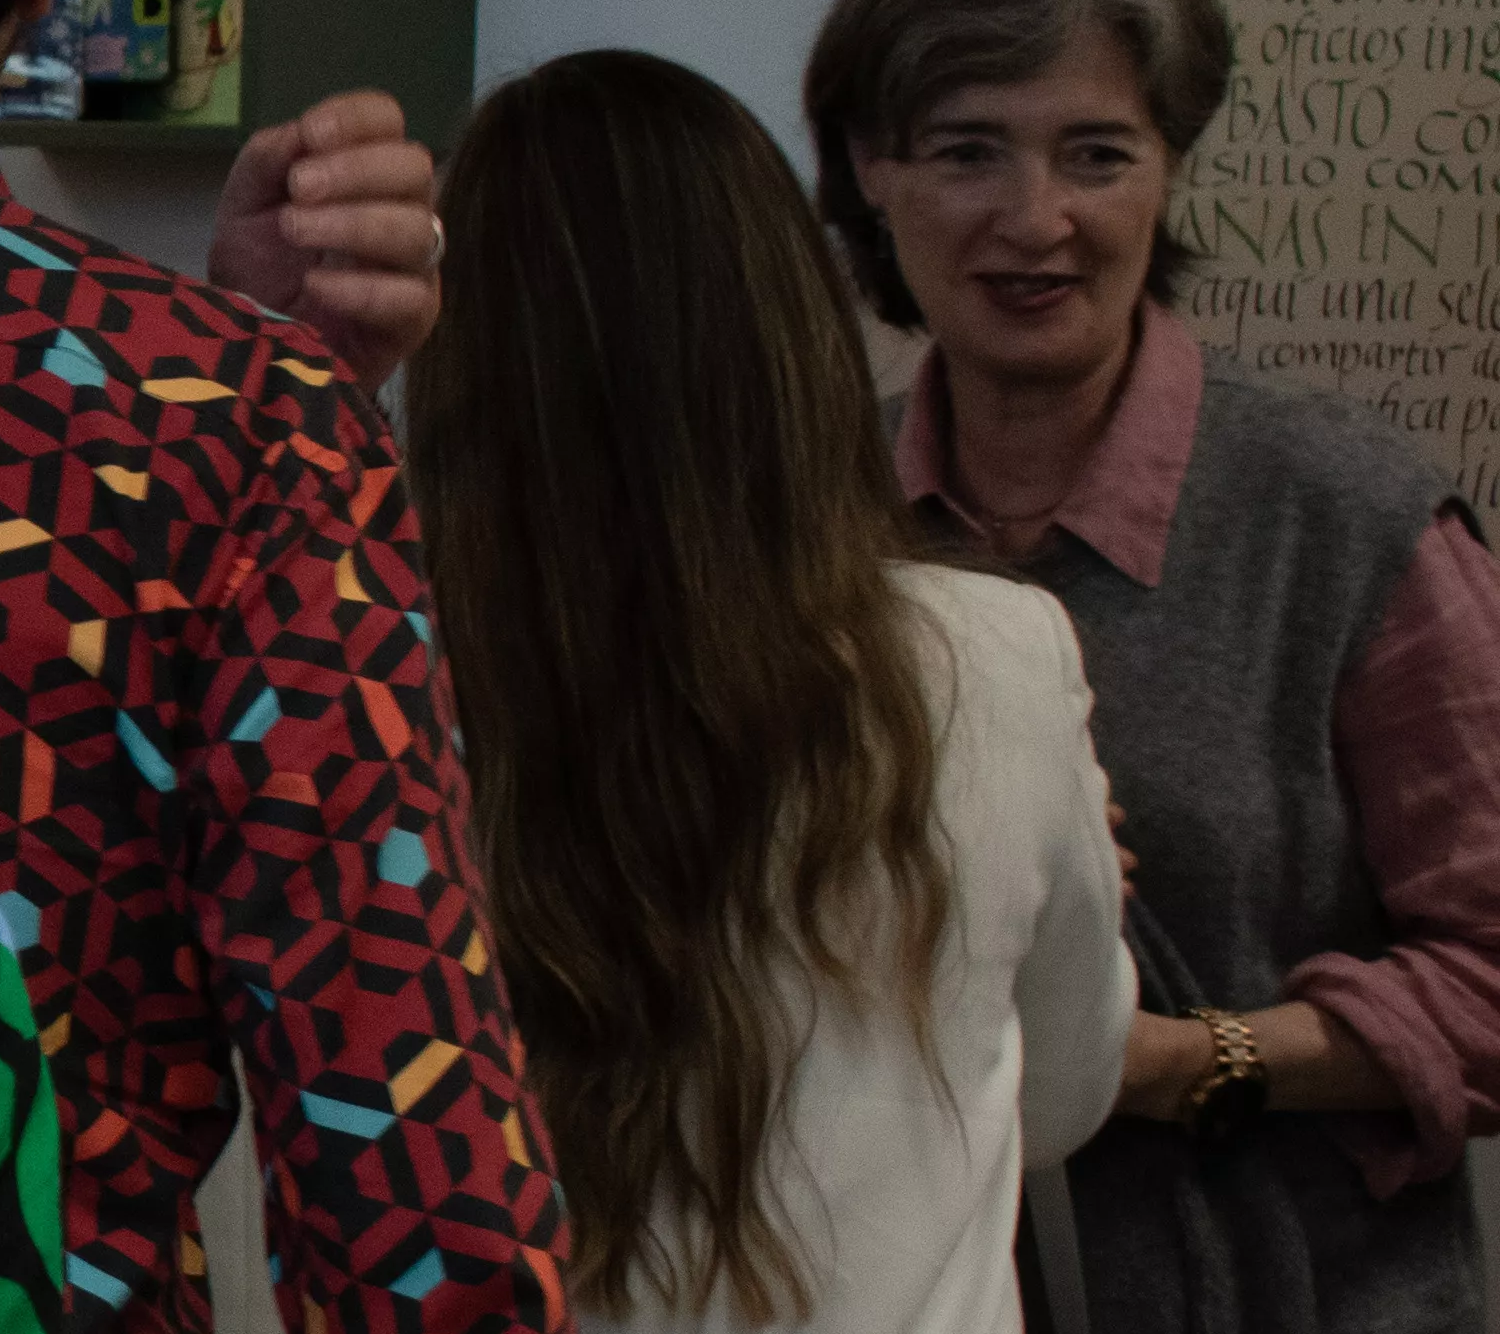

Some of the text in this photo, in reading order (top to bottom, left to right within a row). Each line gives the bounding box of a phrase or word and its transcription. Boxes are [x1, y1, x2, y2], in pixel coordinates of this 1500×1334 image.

[1260, 10, 1408, 100] oficios
[1188, 151, 1337, 189] LSILLO
[1177, 196, 1334, 269] AÑAS
[1358, 202, 1445, 269] EN
[1321, 277, 1417, 323] una
[1257, 335, 1471, 393] compartir
